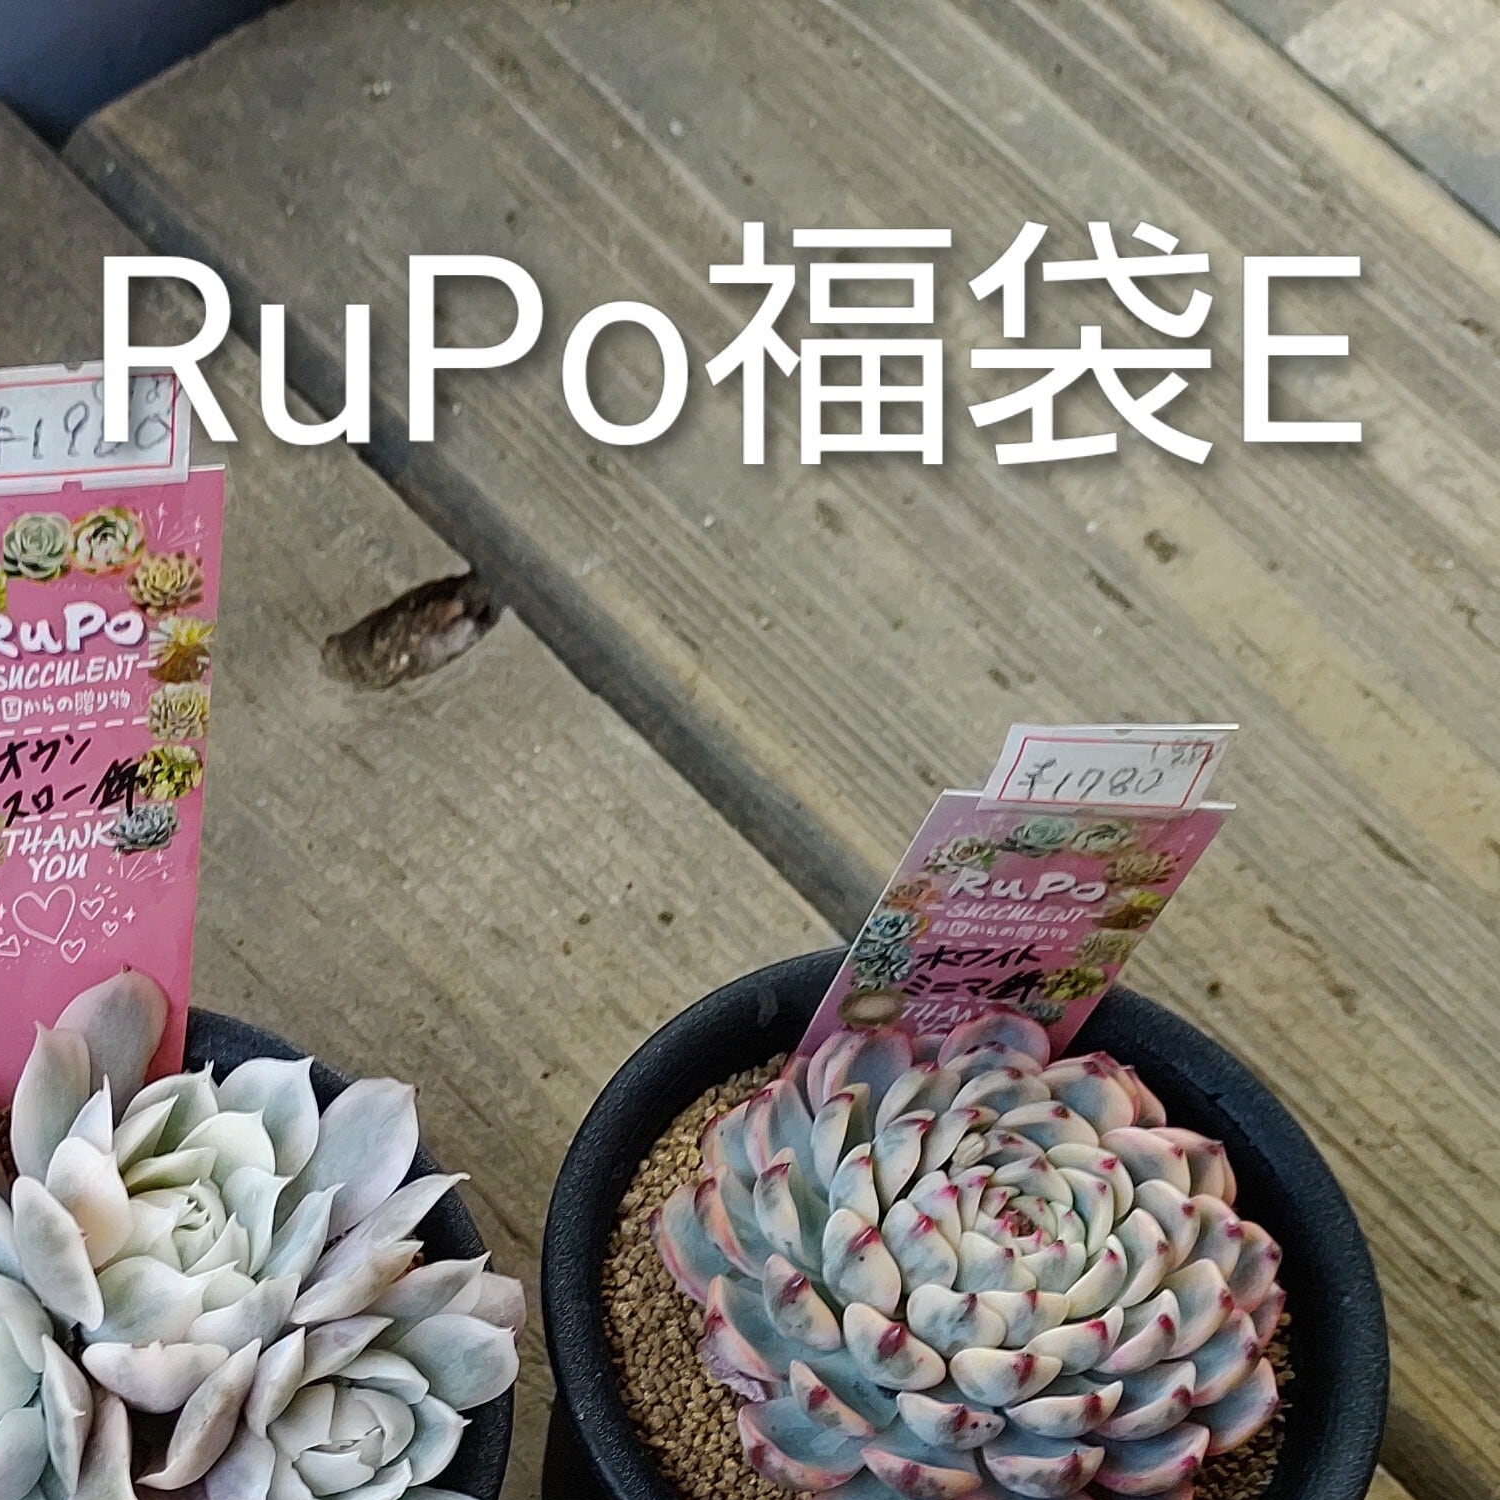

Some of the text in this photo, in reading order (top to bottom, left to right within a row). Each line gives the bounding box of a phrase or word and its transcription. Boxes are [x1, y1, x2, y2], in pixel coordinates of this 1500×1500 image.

[2, 820, 117, 857] THANK
[28, 853, 88, 882] YOU
[948, 870, 1107, 901] RuPo
[945, 902, 1087, 923] SUCCULENT
[914, 943, 1041, 970] ホワイト
